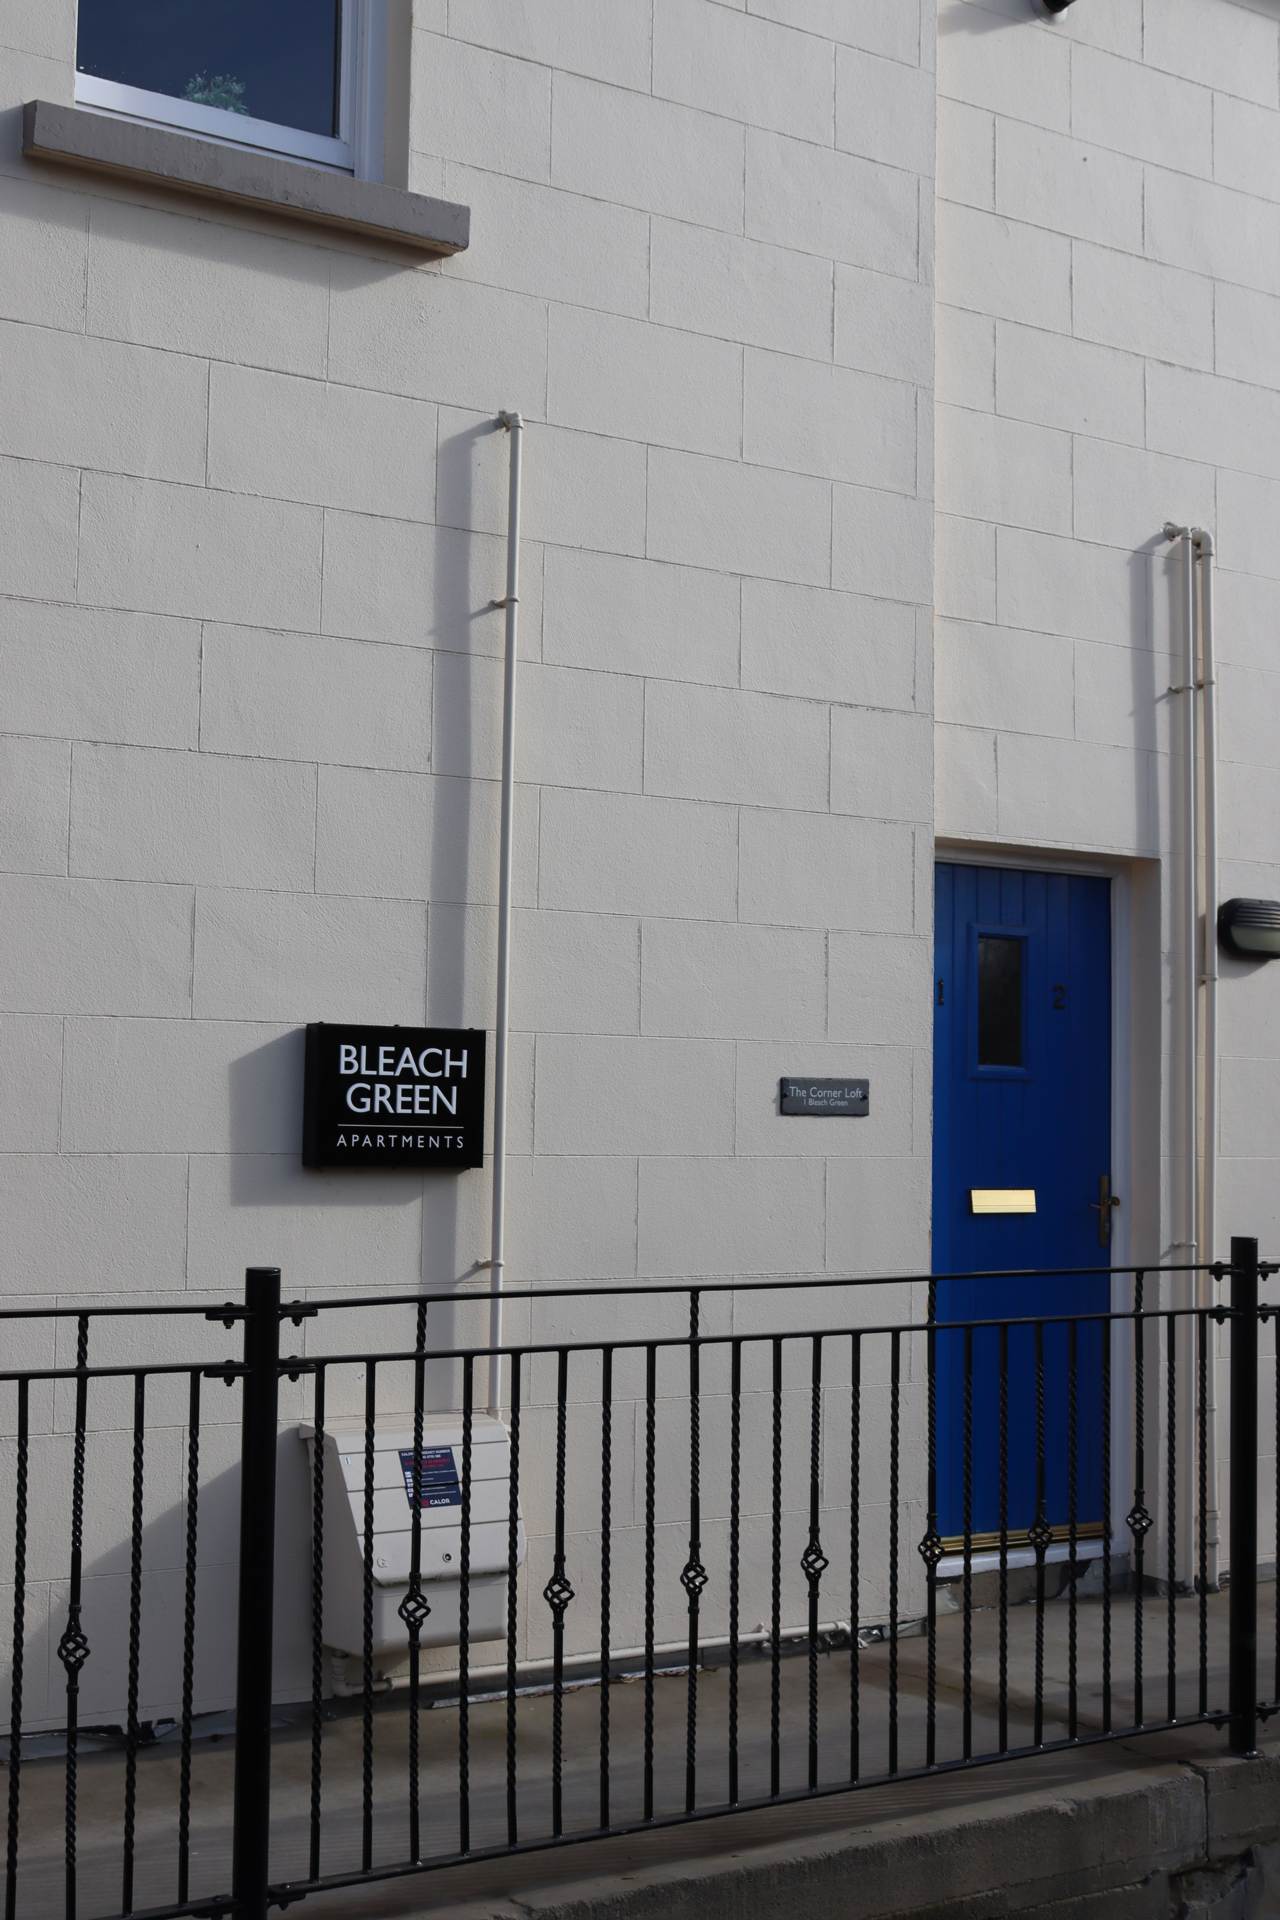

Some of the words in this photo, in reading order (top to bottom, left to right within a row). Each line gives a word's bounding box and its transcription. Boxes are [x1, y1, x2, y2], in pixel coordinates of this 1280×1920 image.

[1051, 983, 1067, 1009] 2
[338, 1044, 469, 1079] BLEACH
[345, 1082, 458, 1115] GREEN
[789, 1086, 807, 1097] The
[809, 1086, 843, 1098] Corner
[844, 1087, 863, 1098] Loft
[808, 1098, 828, 1106] Bleach
[829, 1098, 848, 1106] Green
[336, 1133, 465, 1149] APARTMENTS
[429, 1497, 451, 1505] CALOR
